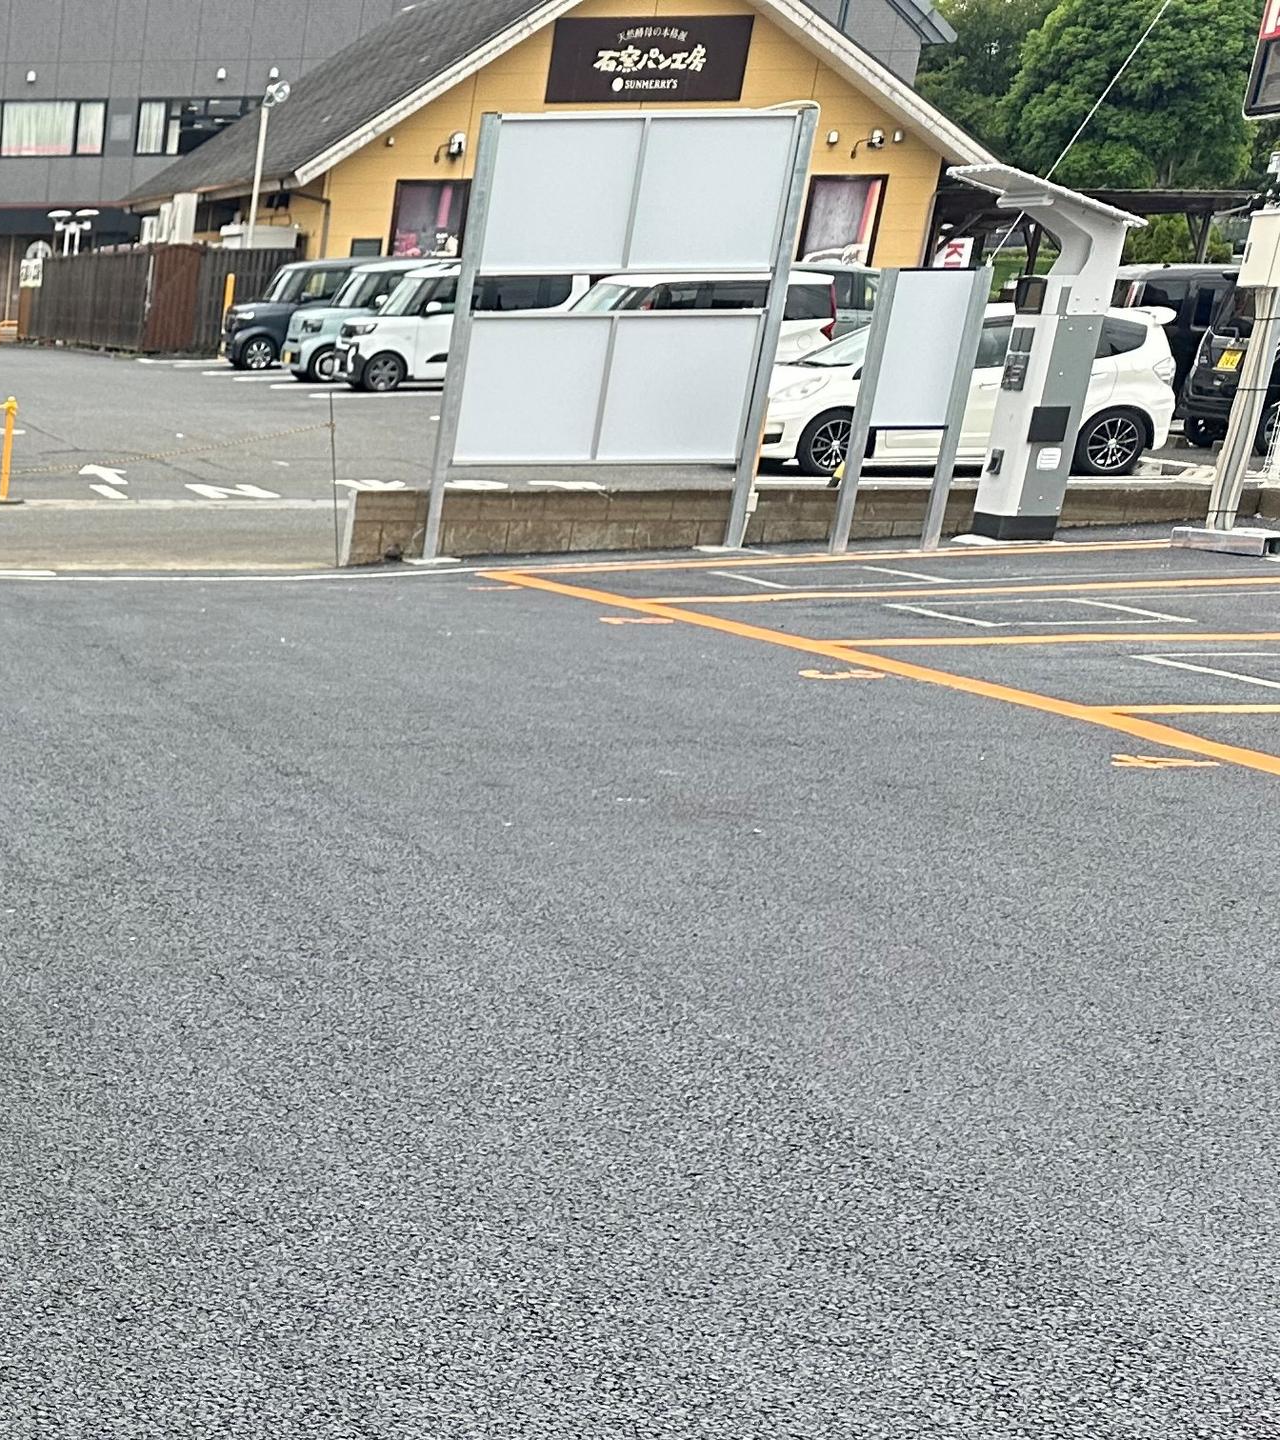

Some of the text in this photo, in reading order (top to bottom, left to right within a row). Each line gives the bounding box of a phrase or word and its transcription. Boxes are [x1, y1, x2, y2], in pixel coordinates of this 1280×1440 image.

[593, 44, 707, 73] 石窯パン工房
[625, 78, 678, 90] SUNMERRY'S
